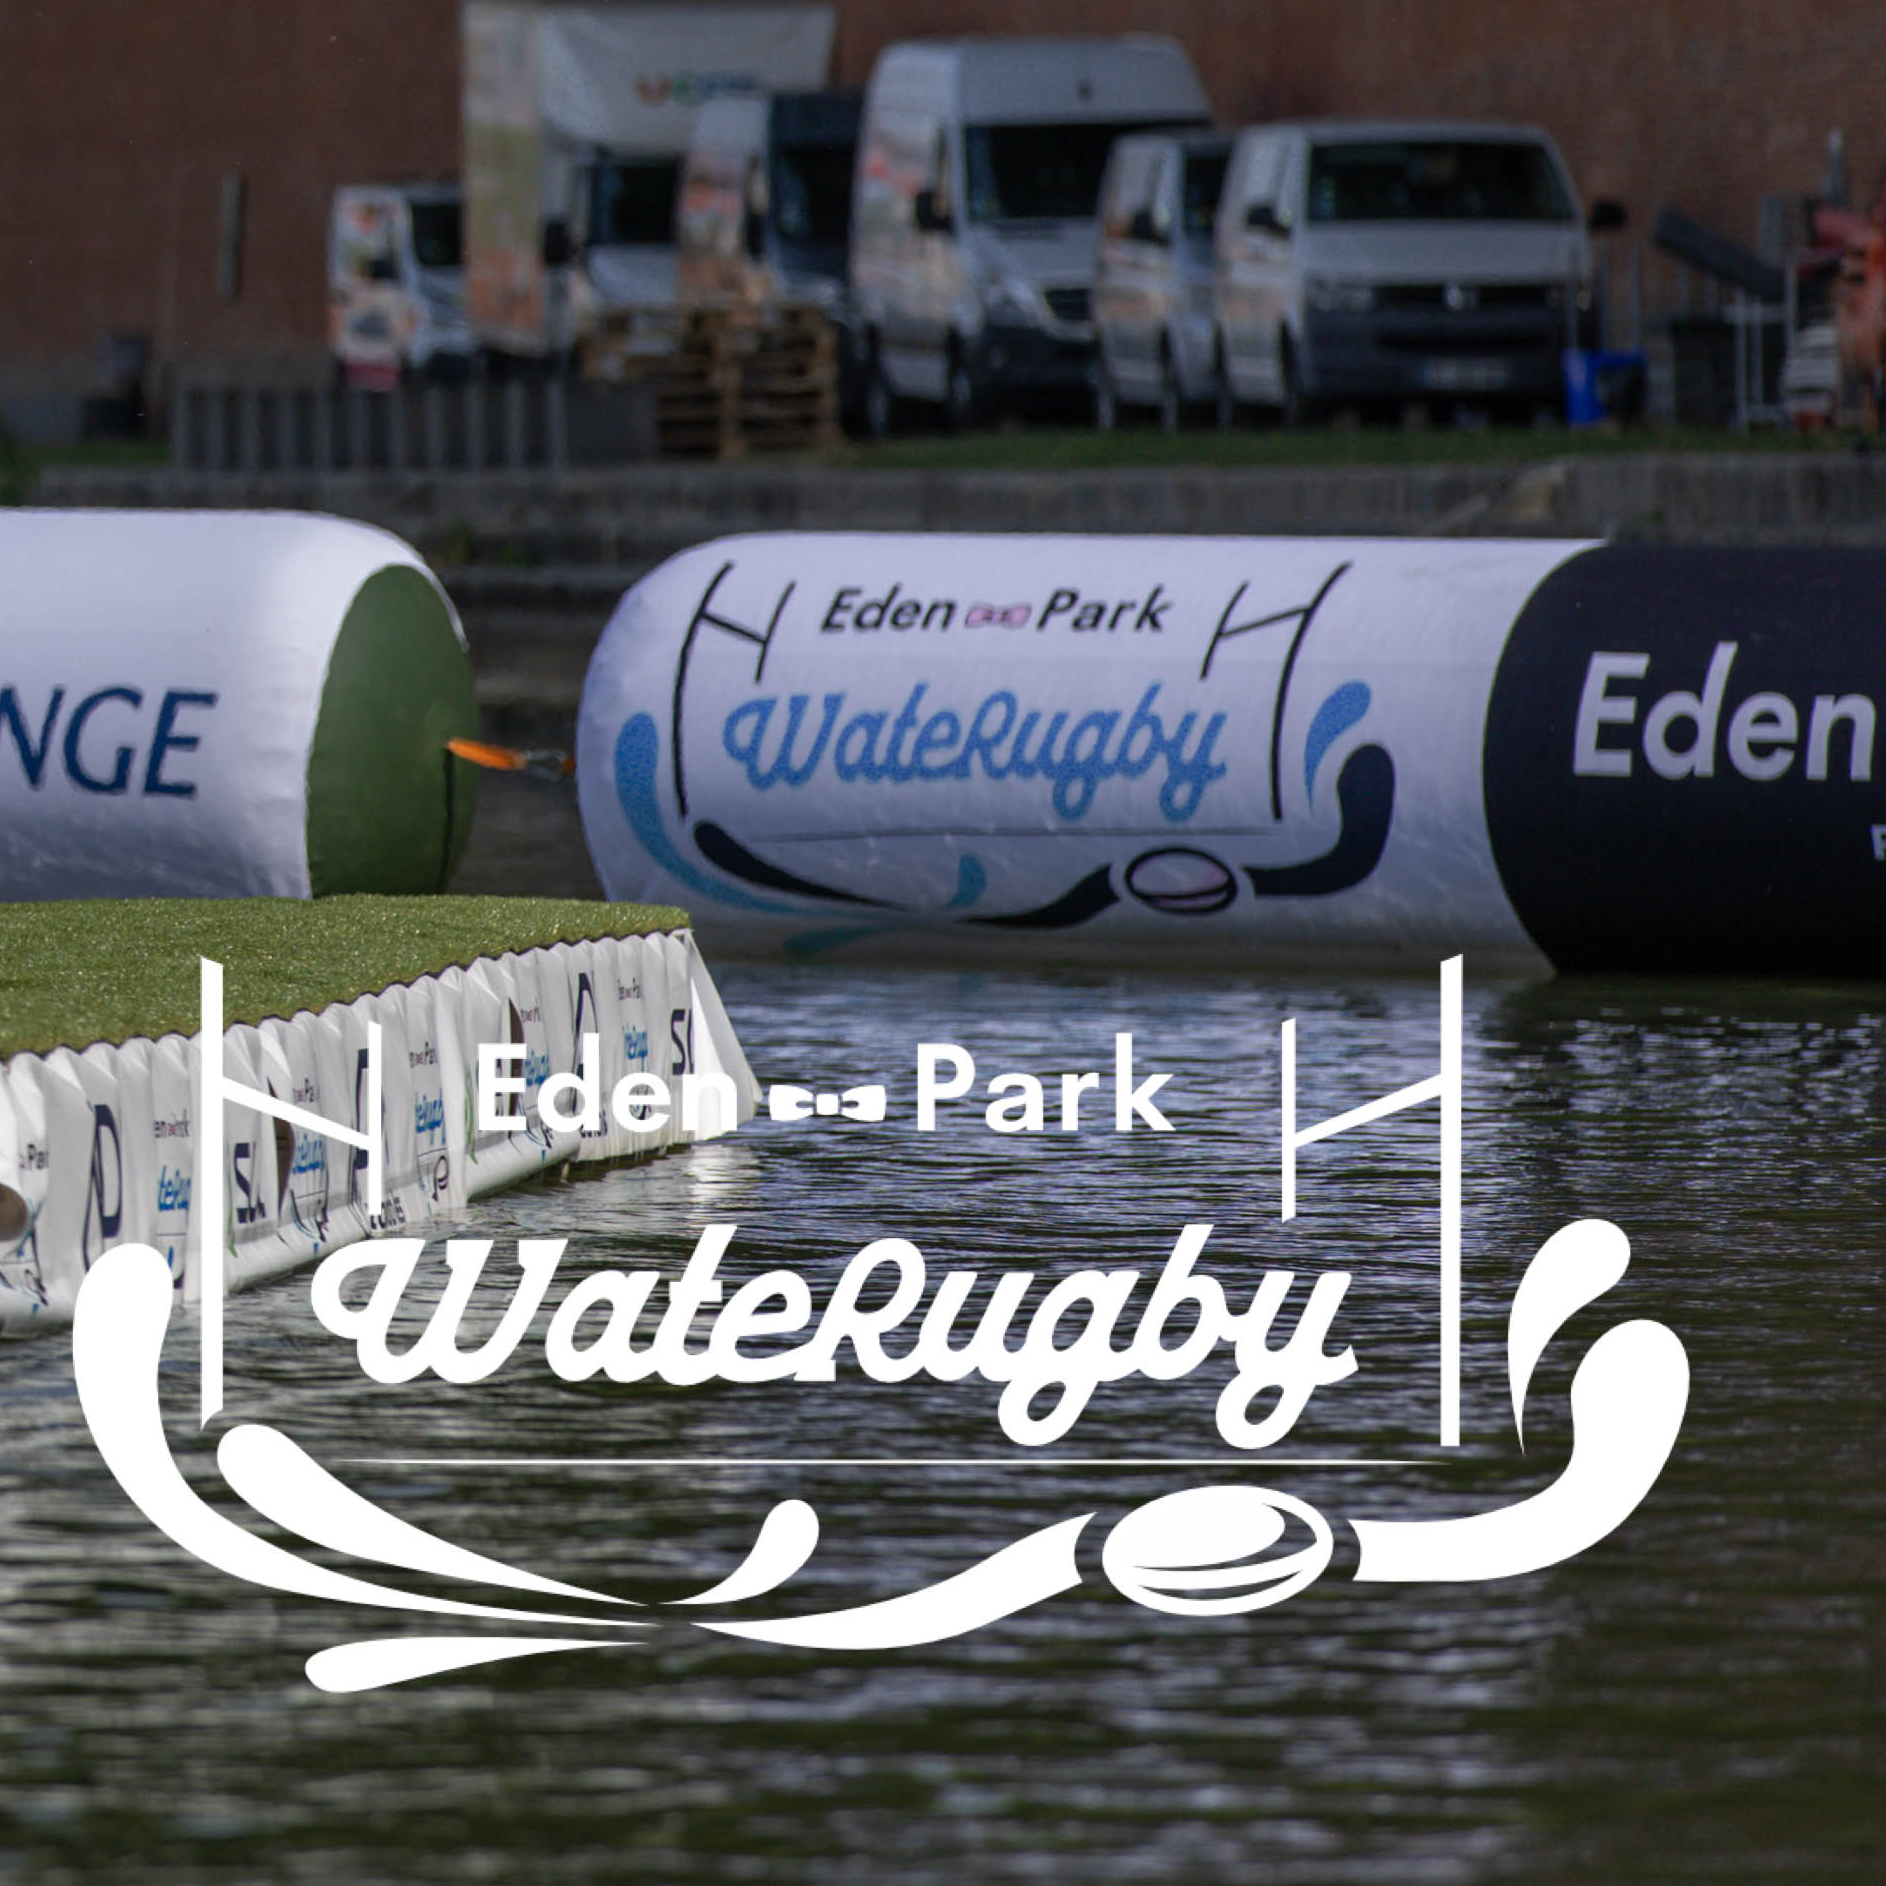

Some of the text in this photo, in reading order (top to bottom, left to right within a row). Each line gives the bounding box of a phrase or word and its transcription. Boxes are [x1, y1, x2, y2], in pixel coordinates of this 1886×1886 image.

[820, 583, 1173, 633] Eden Park
[723, 682, 1227, 822] WateRugby
[1573, 640, 1877, 781] Eden
